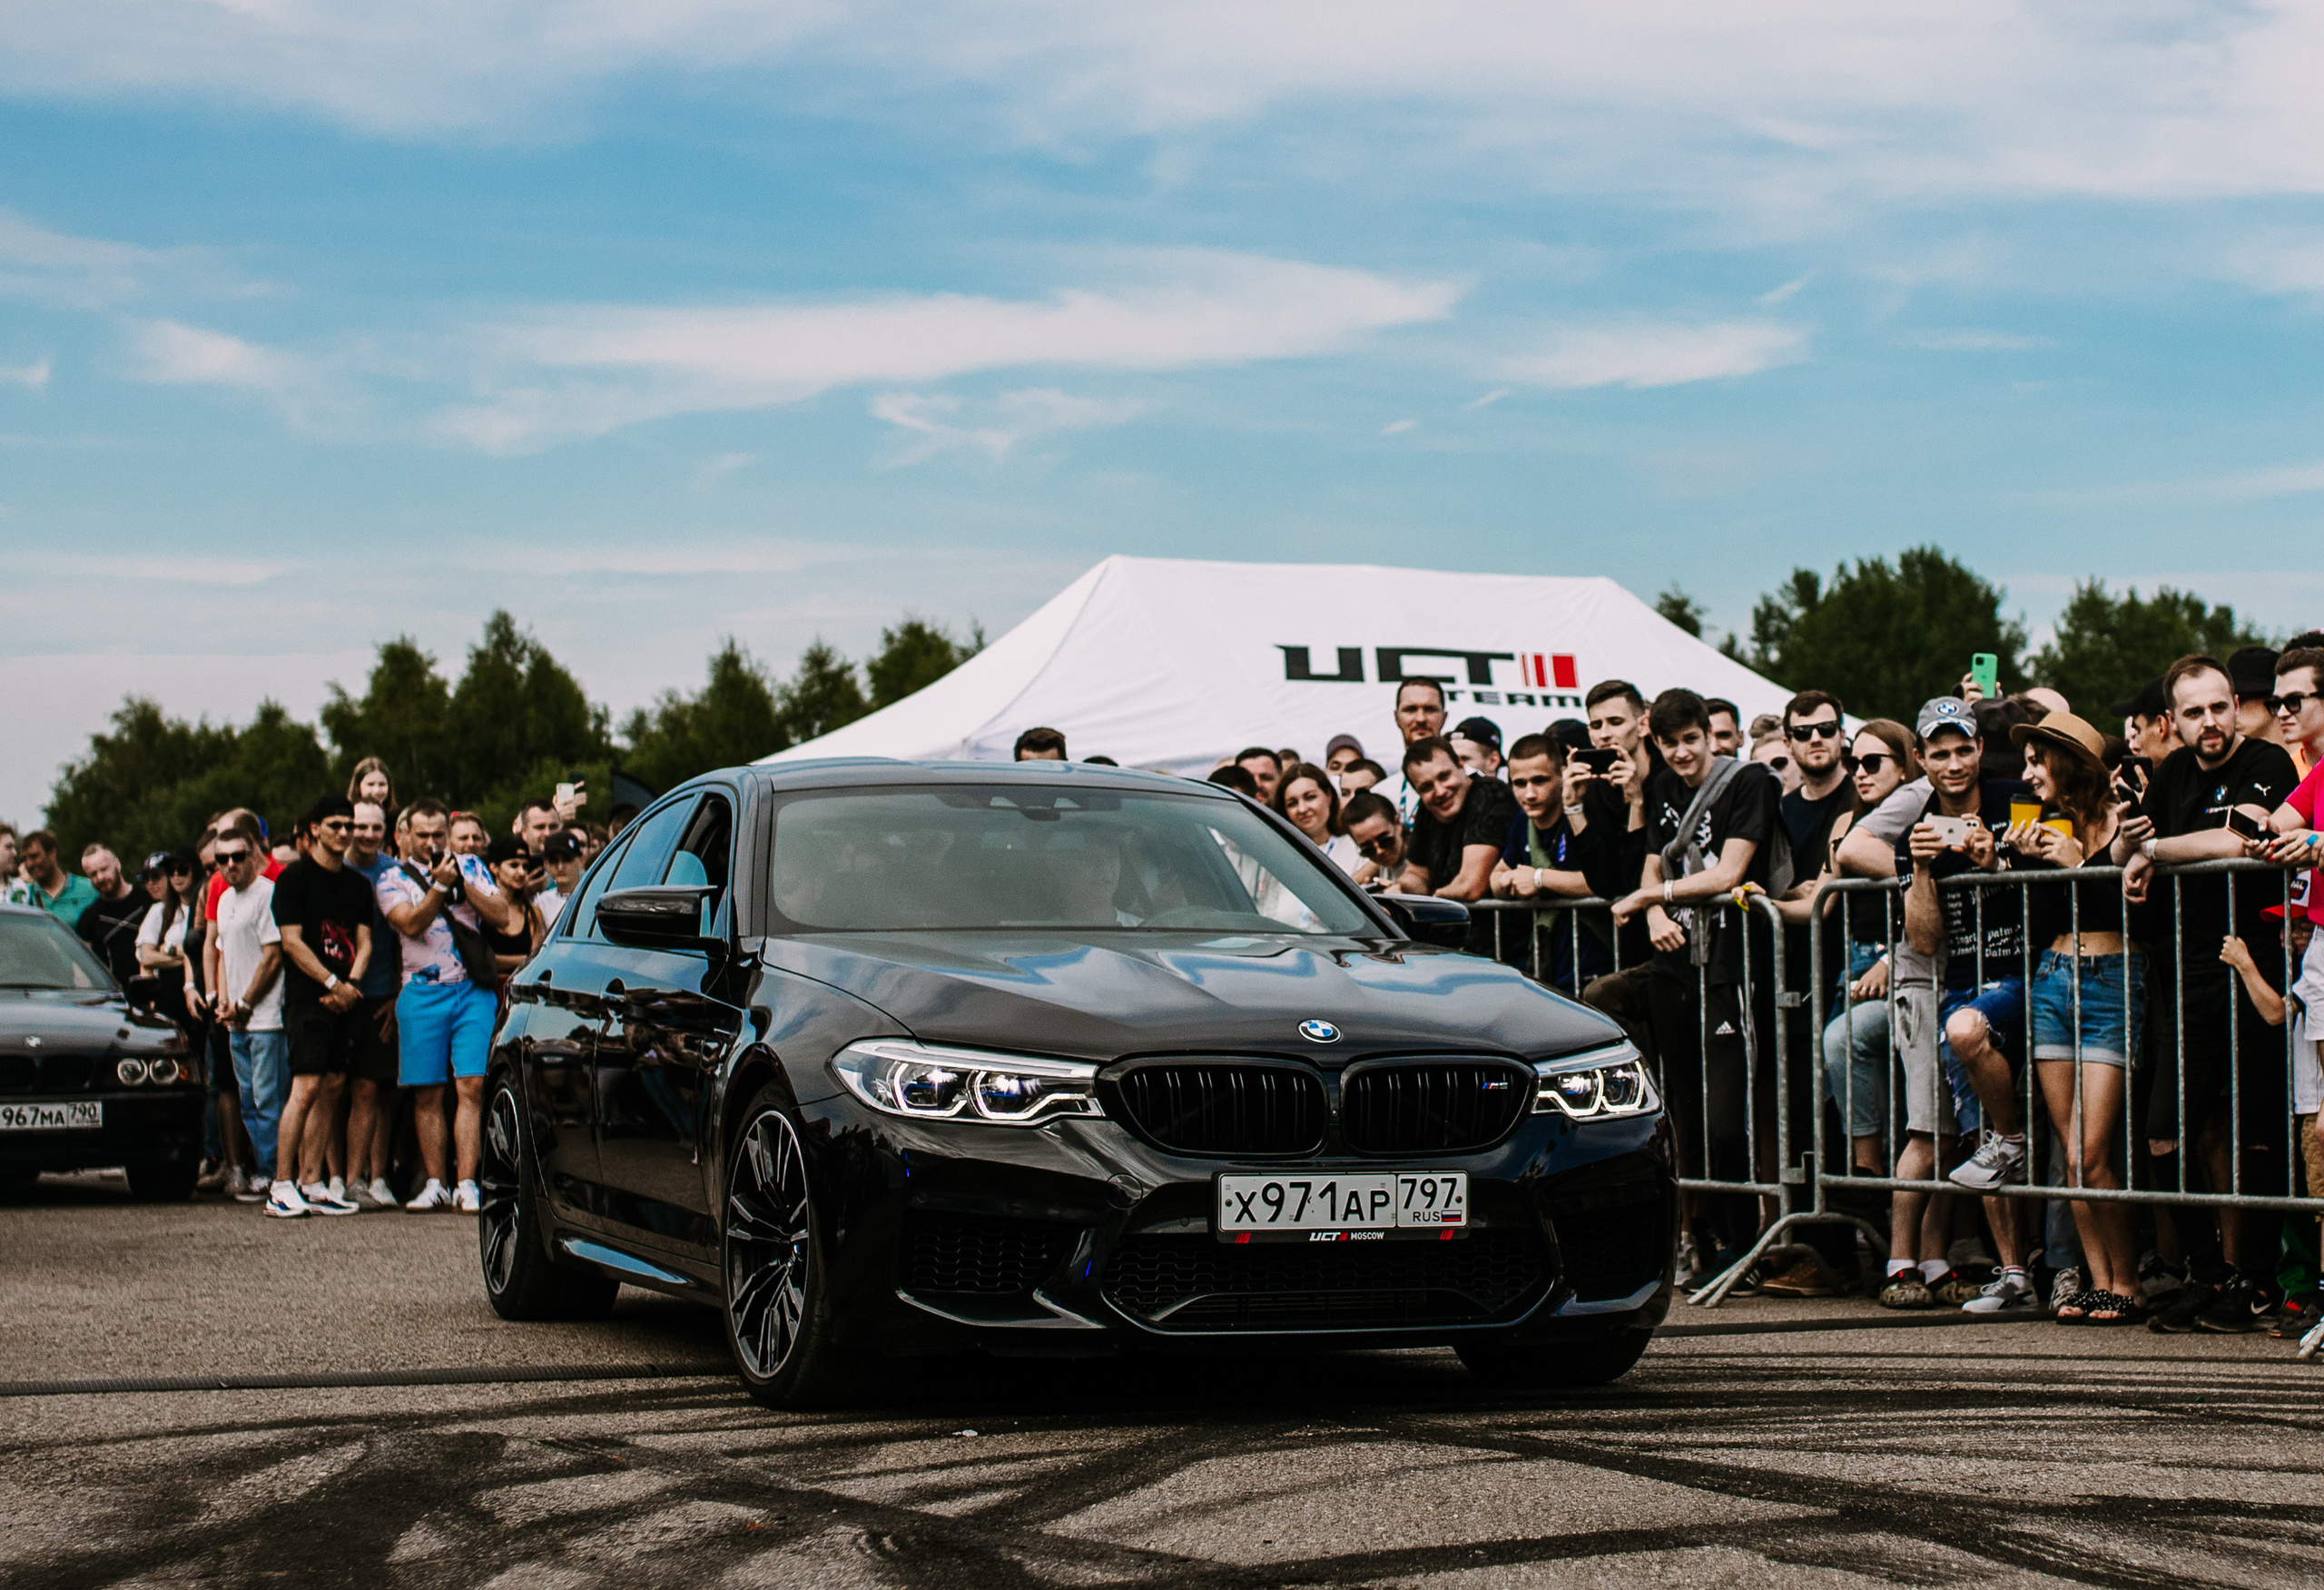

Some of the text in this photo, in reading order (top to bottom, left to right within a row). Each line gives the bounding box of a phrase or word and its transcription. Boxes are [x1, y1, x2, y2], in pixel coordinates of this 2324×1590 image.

[1443, 690, 1582, 708] TEAM
[1400, 1177, 1458, 1210] 797
[1413, 1211, 1440, 1222] RUS
[1350, 1231, 1384, 1240] MOSCOW
